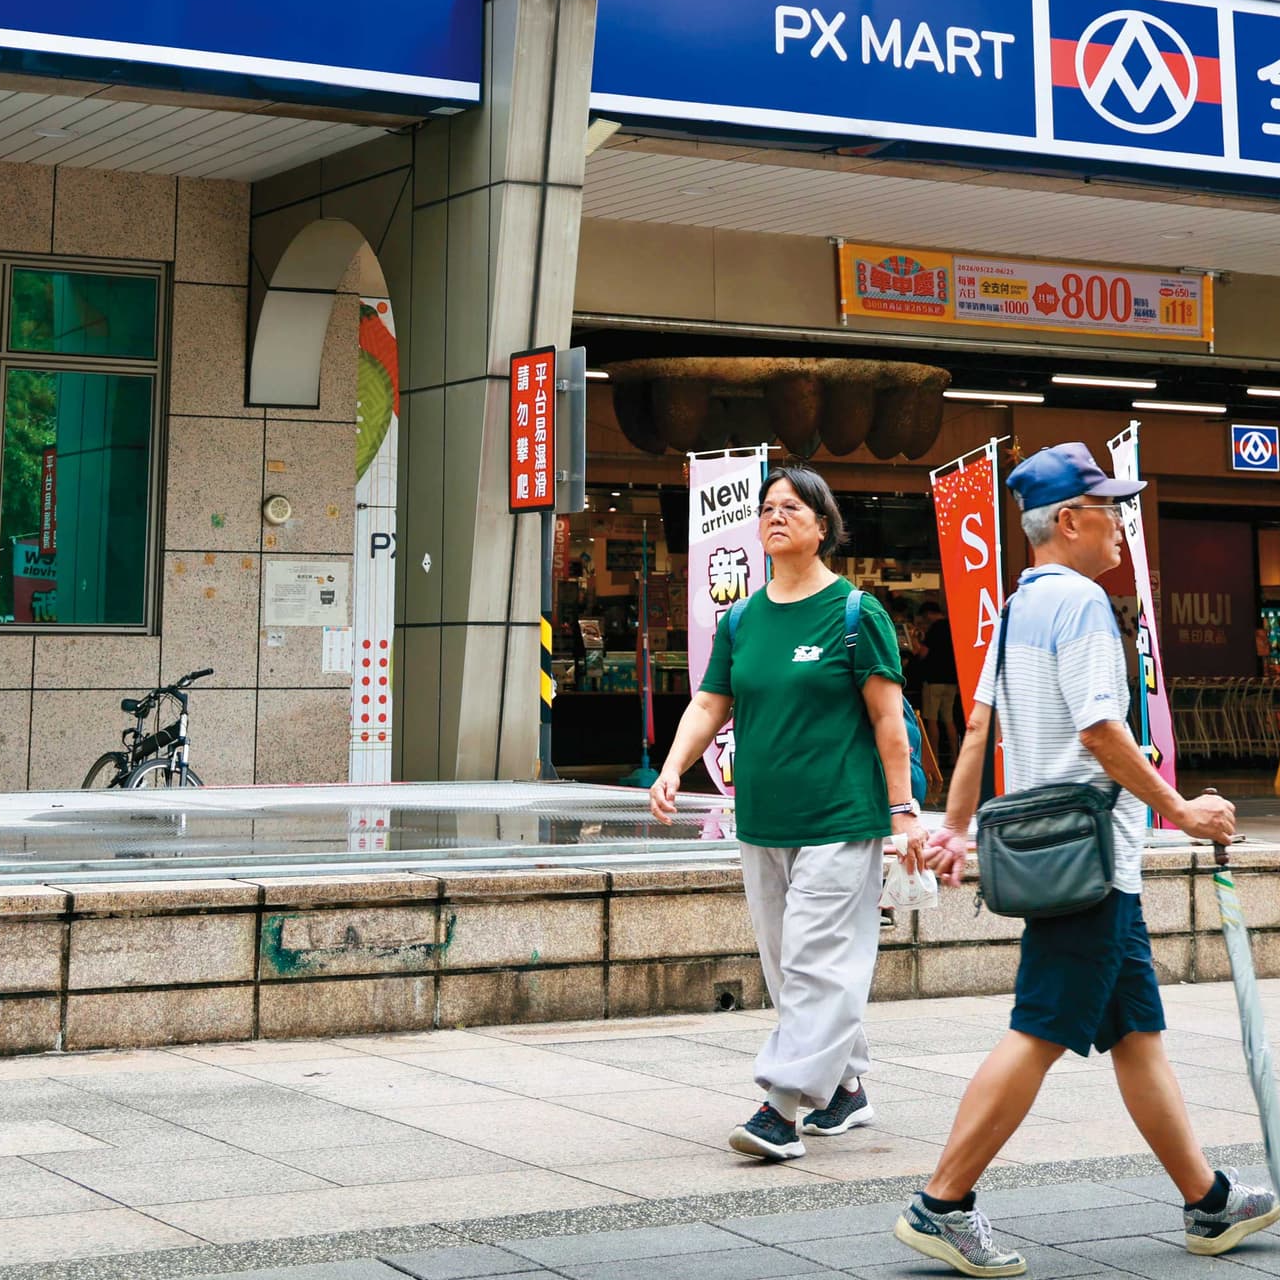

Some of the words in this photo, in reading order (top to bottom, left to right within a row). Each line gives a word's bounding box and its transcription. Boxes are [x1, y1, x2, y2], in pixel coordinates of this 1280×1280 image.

[775, 5, 848, 62] PX
[861, 14, 1015, 80] MART
[981, 281, 1010, 295] 全支付
[1061, 273, 1133, 323] 800
[516, 365, 530, 499] 請勿攀爬
[534, 362, 548, 498] 平台易濕滑
[700, 478, 750, 516] New
[701, 504, 752, 534] arrivals
[1171, 591, 1232, 625] MUJI
